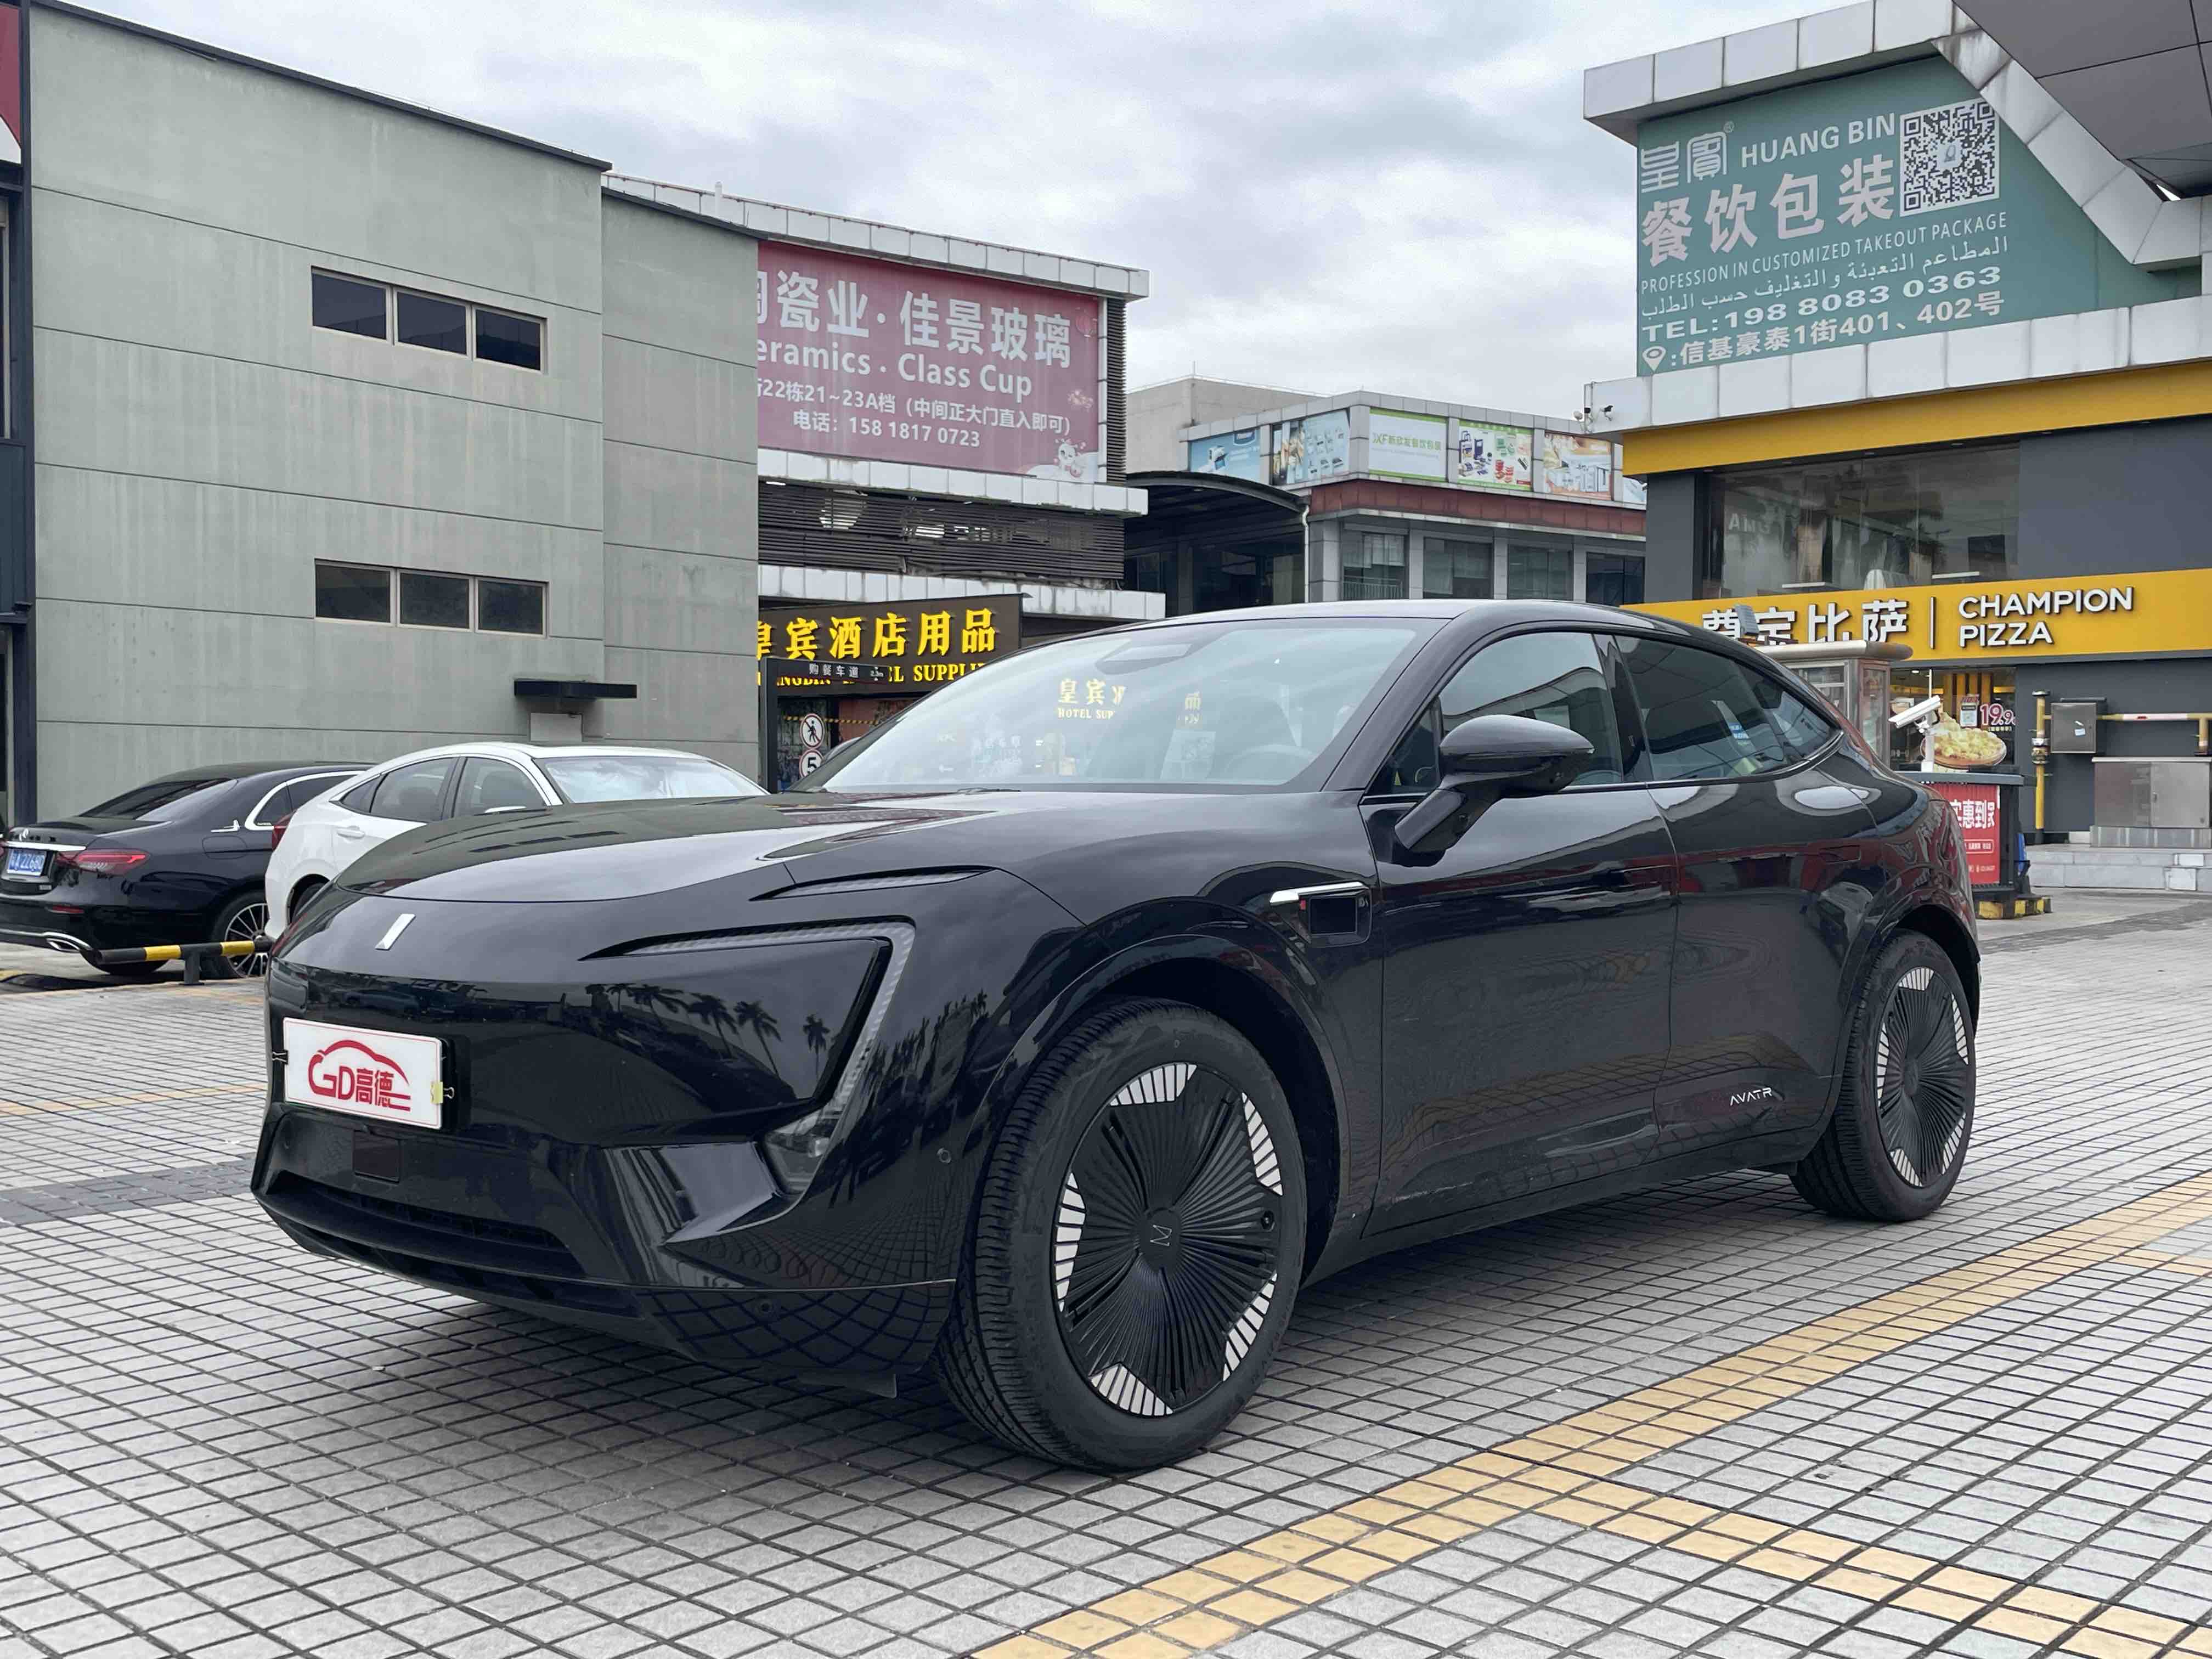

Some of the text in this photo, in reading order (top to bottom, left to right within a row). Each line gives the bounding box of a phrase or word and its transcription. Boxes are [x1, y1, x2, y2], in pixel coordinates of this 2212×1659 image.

[1741, 112, 1895, 168] HUANG BIN
[1641, 154, 1894, 268] 餐饮包装
[1641, 212, 2007, 295] PROFESSION IN CUSTOMIZED TAKEOUT PACKAGE
[1922, 236, 2008, 275] المطاعم
[1701, 290, 1748, 309] حسب
[1798, 285, 1890, 316] 8083
[1903, 266, 2001, 298] 0363
[1641, 293, 1695, 320] الطلب
[898, 353, 970, 388] Class
[979, 364, 1032, 403] Cup
[888, 421, 932, 442] 1817
[937, 427, 980, 448] 0723
[1958, 586, 2134, 619] CHAMPION
[1959, 621, 2054, 648] PIZZA
[1096, 710, 1115, 720] SUP
[807, 757, 817, 774] 5
[1730, 1087, 1773, 1106] AVATR
